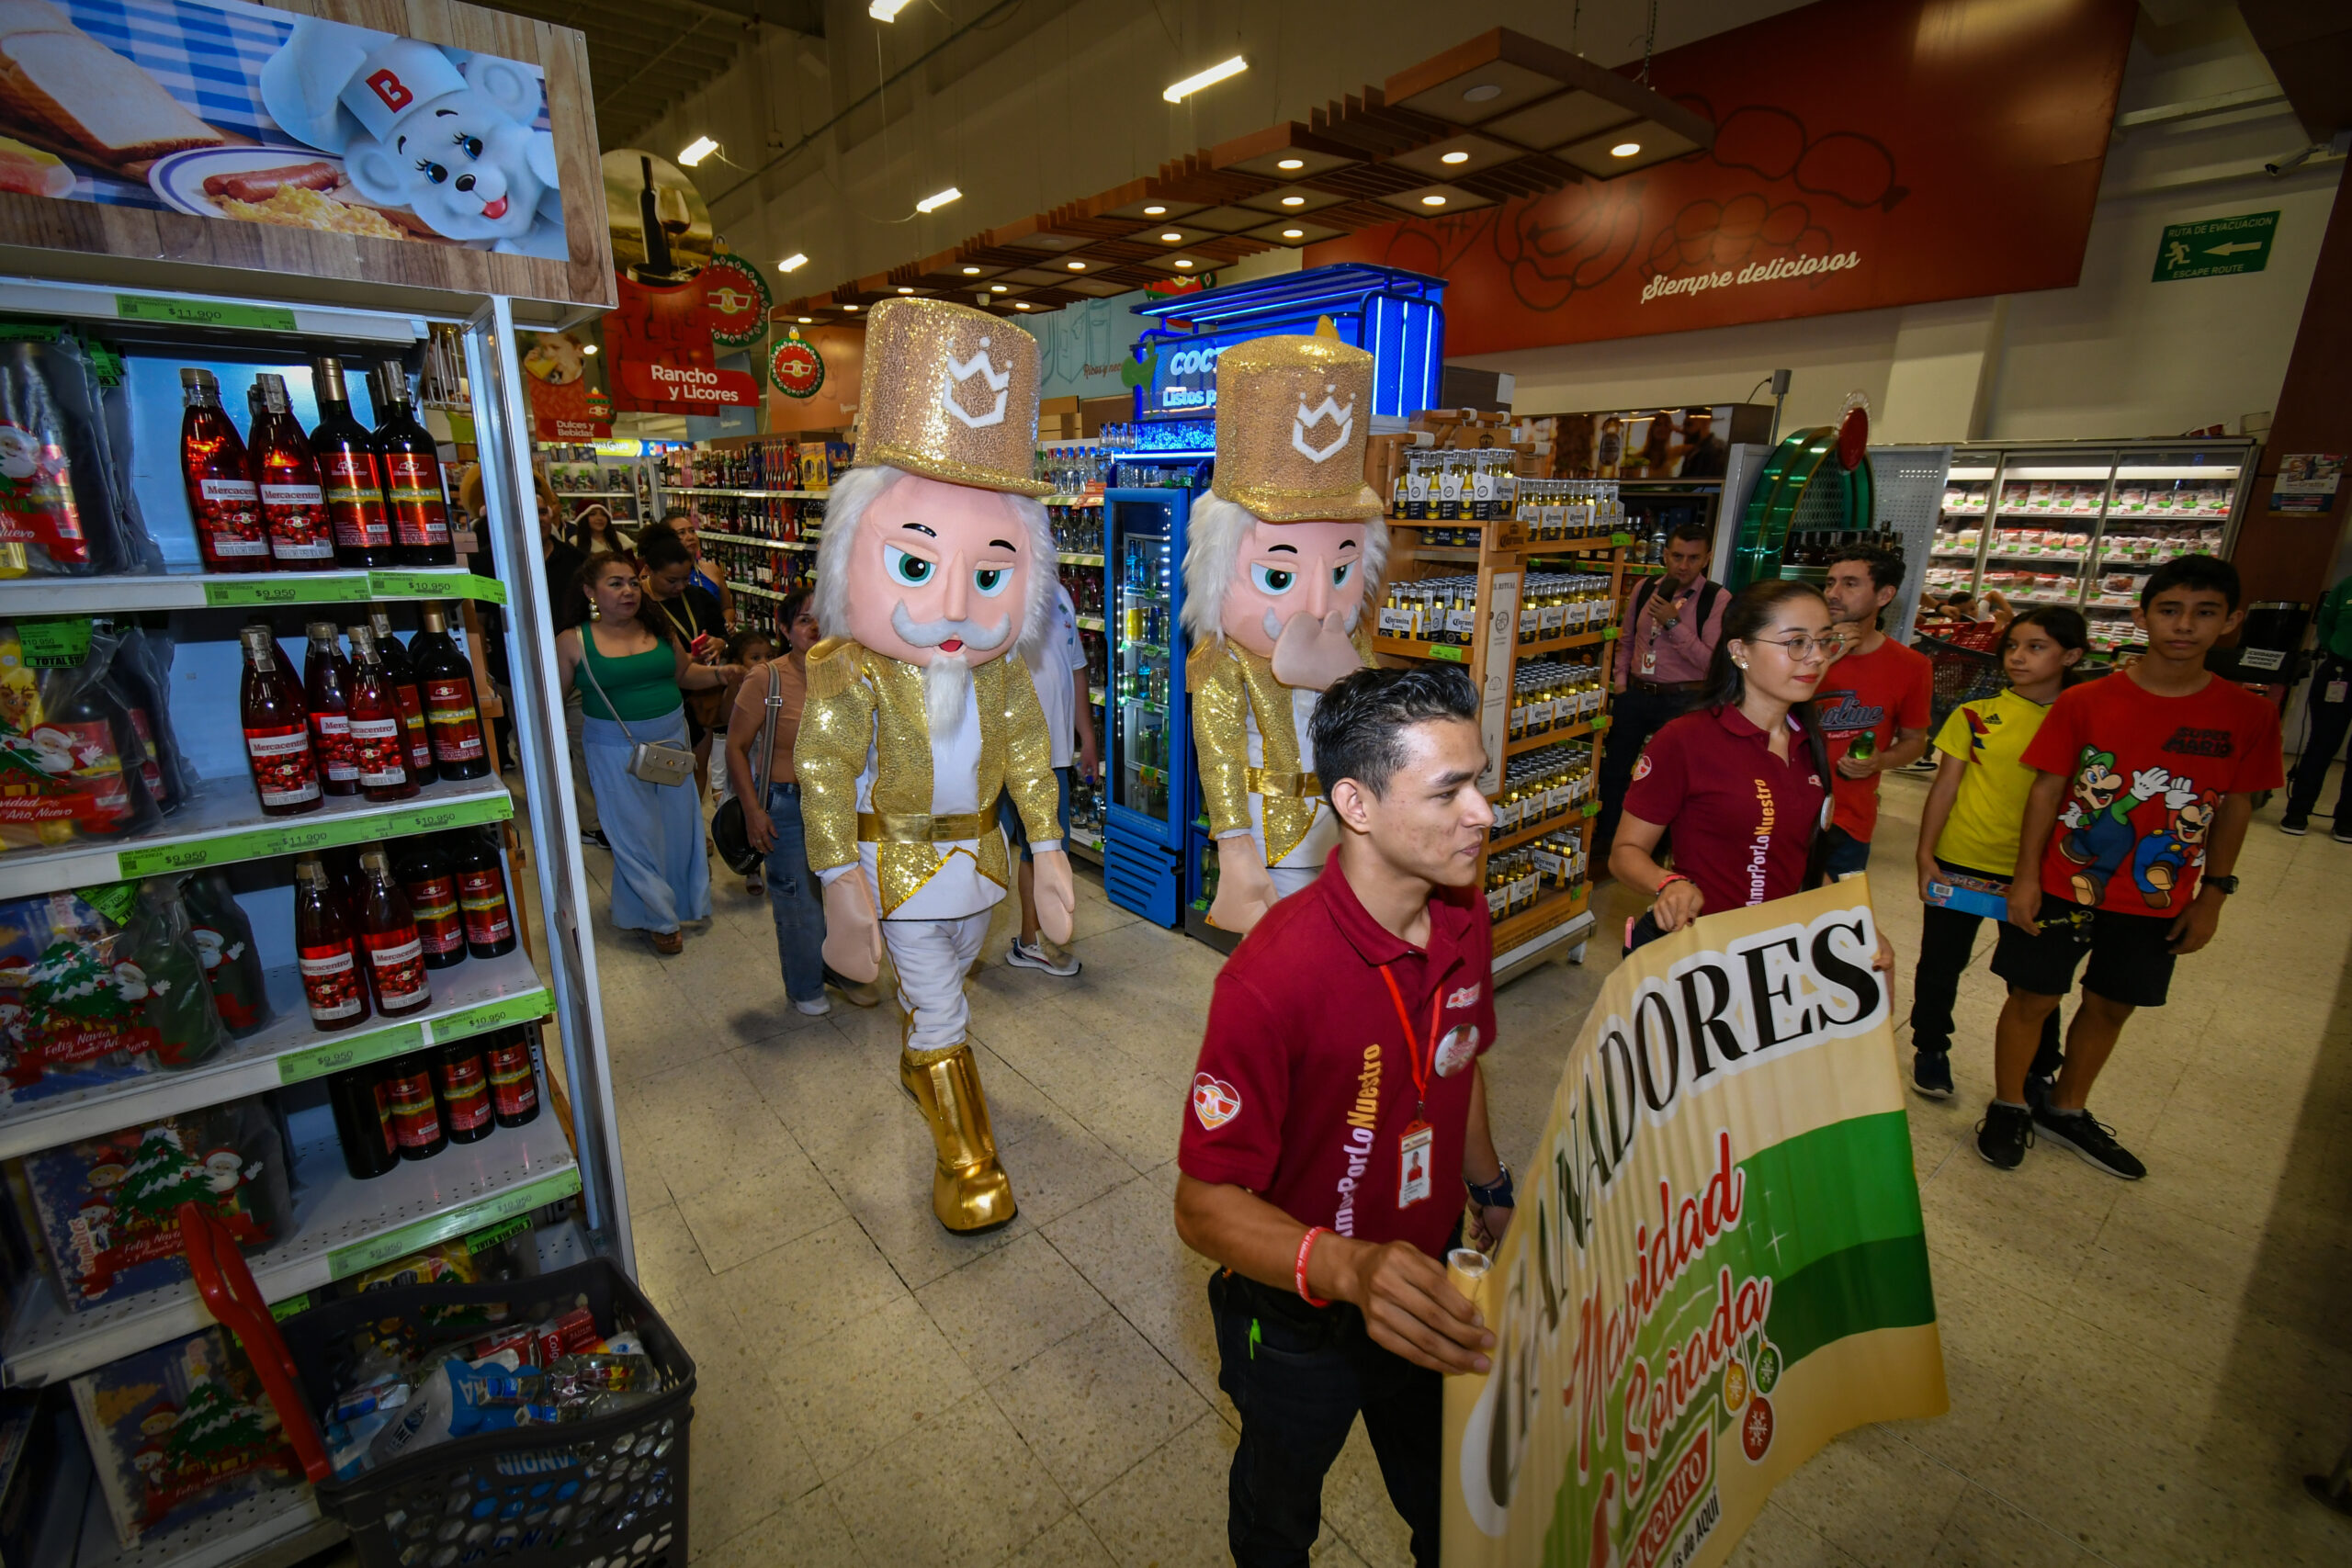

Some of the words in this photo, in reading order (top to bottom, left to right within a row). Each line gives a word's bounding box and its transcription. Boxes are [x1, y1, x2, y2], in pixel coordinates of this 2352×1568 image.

[365, 69, 413, 113] B
[2167, 227, 2192, 238] RUTA
[2194, 225, 2207, 235] DE
[1640, 270, 1735, 304] Siempre
[1736, 251, 1861, 285] deliciosos
[2173, 266, 2211, 279] ESCAPE
[2211, 264, 2245, 275] ROUTE
[650, 365, 718, 386] Rancho
[668, 387, 680, 400] y
[683, 385, 740, 402] Licores
[1163, 391, 1204, 408] Listos
[556, 420, 588, 430] Dulces
[557, 428, 594, 438] Bebidas
[207, 484, 256, 496] Mercacen
[264, 489, 321, 501] Mercacentro
[1453, 618, 1474, 626] Coroni
[35, 656, 67, 666] TOTAL
[1819, 696, 1883, 724] oline
[349, 726, 393, 736] rcacentro
[0, 796, 40, 807] vidad
[1564, 1133, 1745, 1472] Navidad
[548, 1334, 560, 1364] Colg
[1624, 1268, 1770, 1495] Soñada
[1695, 1484, 1721, 1542] AQUÍ
